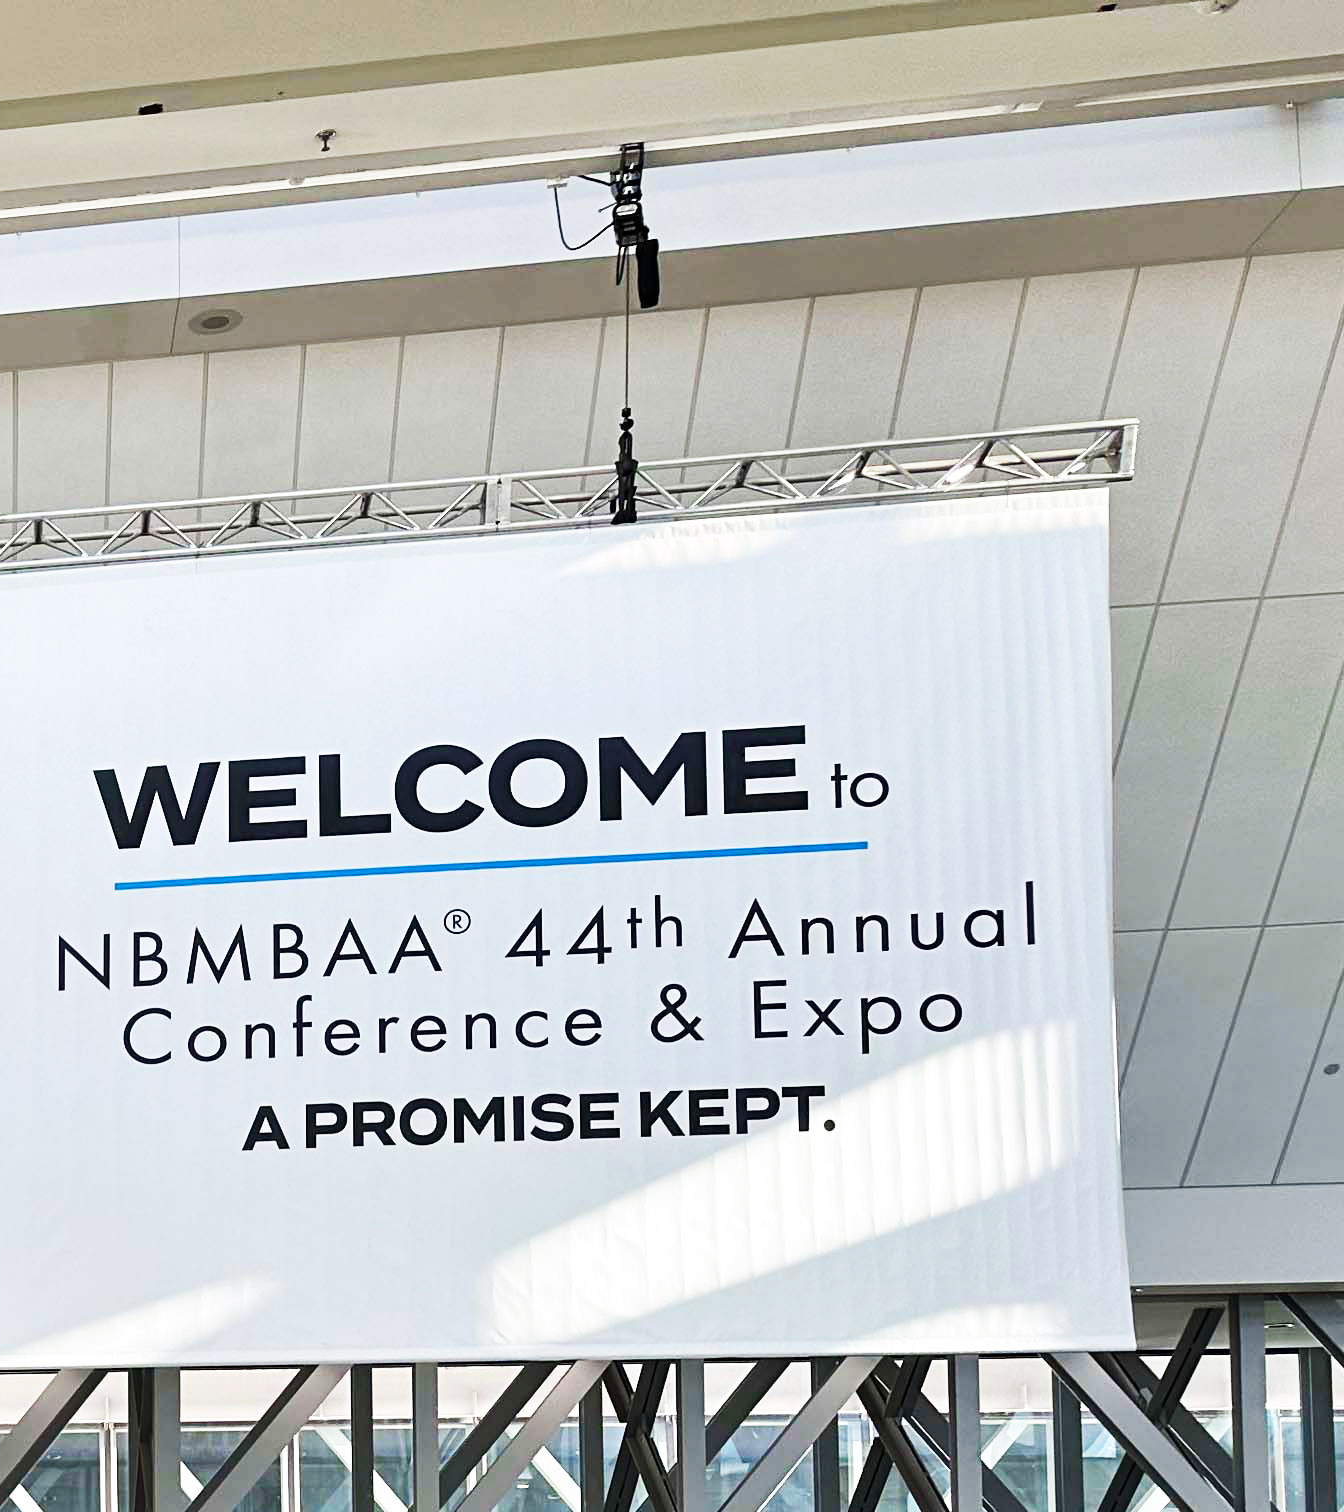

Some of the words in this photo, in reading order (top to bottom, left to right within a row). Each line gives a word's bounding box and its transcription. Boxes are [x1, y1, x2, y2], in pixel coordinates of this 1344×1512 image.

[93, 725, 808, 849] WELCOME
[831, 764, 889, 808] to
[505, 895, 682, 966] 44th
[728, 881, 1035, 958] Annual
[124, 995, 602, 1064] Conference
[651, 984, 704, 1042] &
[754, 980, 962, 1054] Expo
[242, 1106, 290, 1150] A
[306, 1093, 620, 1148] PROMISE
[640, 1086, 835, 1137] KEPT.
